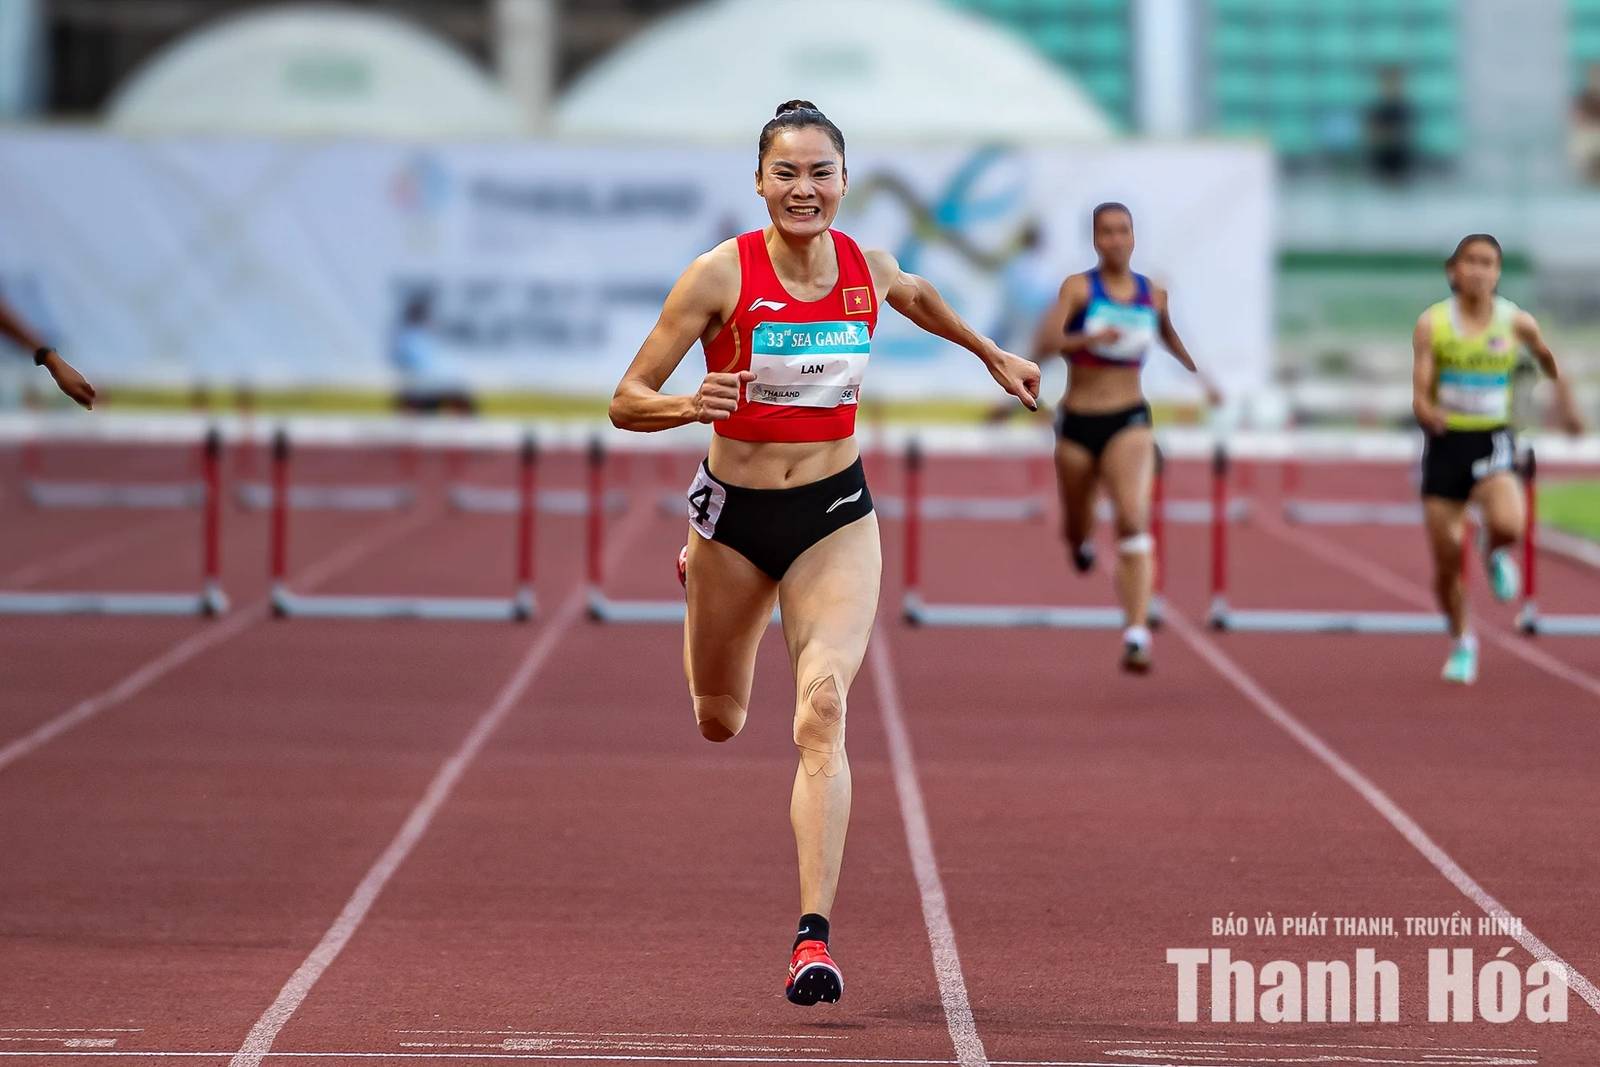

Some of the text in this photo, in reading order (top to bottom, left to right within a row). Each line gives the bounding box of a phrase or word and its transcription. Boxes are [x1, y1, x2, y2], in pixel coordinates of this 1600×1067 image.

[791, 333, 812, 347] SEA
[815, 331, 859, 346] GAMES
[801, 364, 824, 375] LAN
[763, 389, 800, 398] THAILAND
[689, 485, 712, 525] 4
